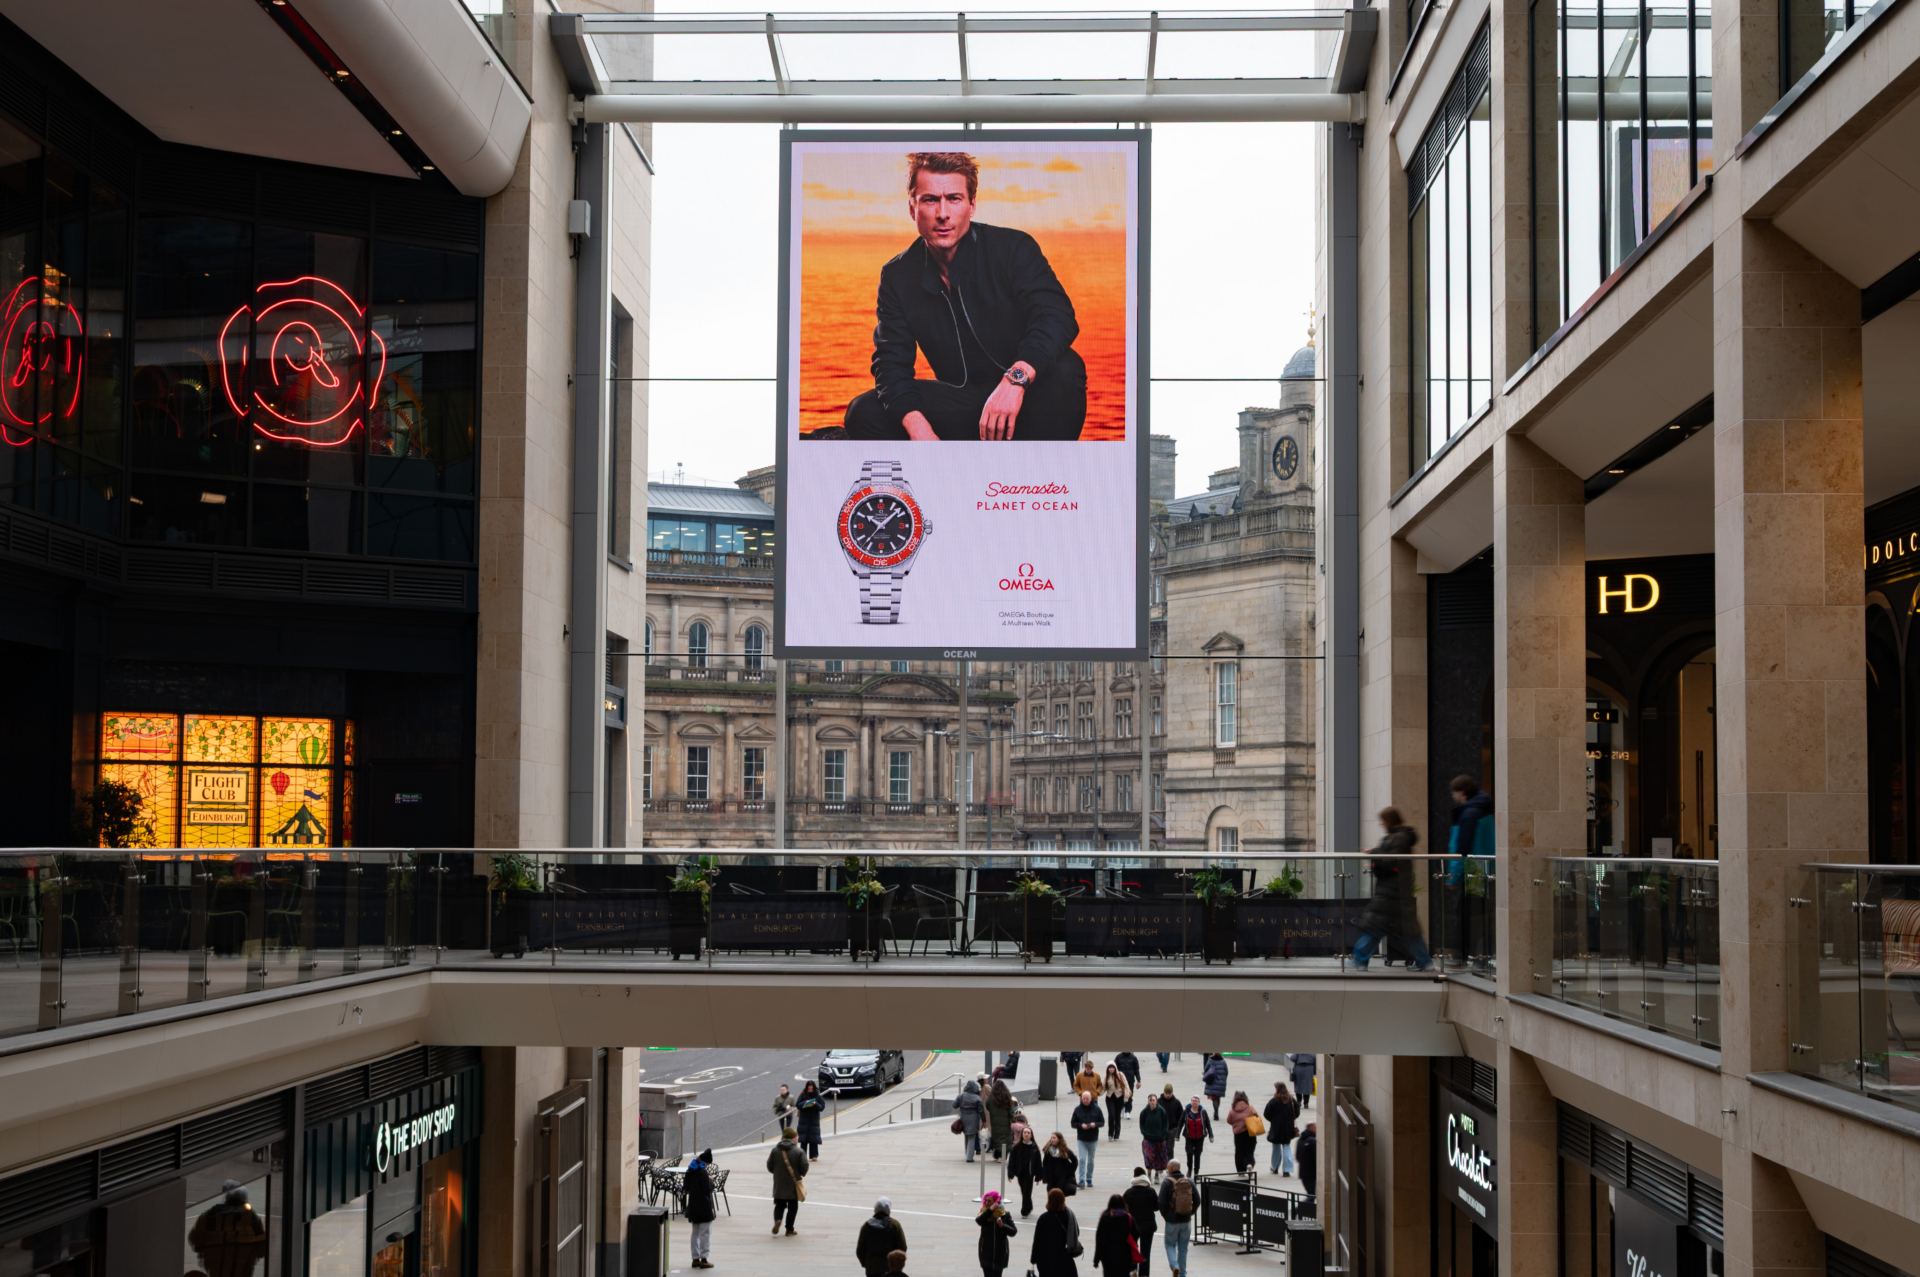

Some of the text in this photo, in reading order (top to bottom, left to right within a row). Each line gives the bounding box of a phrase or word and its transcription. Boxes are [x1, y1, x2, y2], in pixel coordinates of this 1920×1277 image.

[985, 481, 1069, 497] Seamaster
[977, 502, 1078, 511] PLANET OCEAN
[998, 578, 1055, 591] OMEGA
[1598, 573, 1660, 614] HD
[1026, 611, 1054, 620] Boutique
[943, 650, 977, 658] OCEAN
[194, 774, 244, 788] FLIGHT
[202, 787, 236, 800] CLUB
[192, 812, 244, 822] EDINBURGH
[576, 923, 625, 931] EDINBURGH
[754, 924, 802, 933] EDINBURGH
[1112, 927, 1158, 936] EDINBURGH
[1283, 929, 1332, 938] EDINBURGH
[392, 1103, 455, 1156] THE BODY SHOP
[1460, 1112, 1475, 1136] HOTEL
[1211, 1199, 1240, 1211] STARBUCKS
[1255, 1207, 1285, 1219] STARBUCKS
